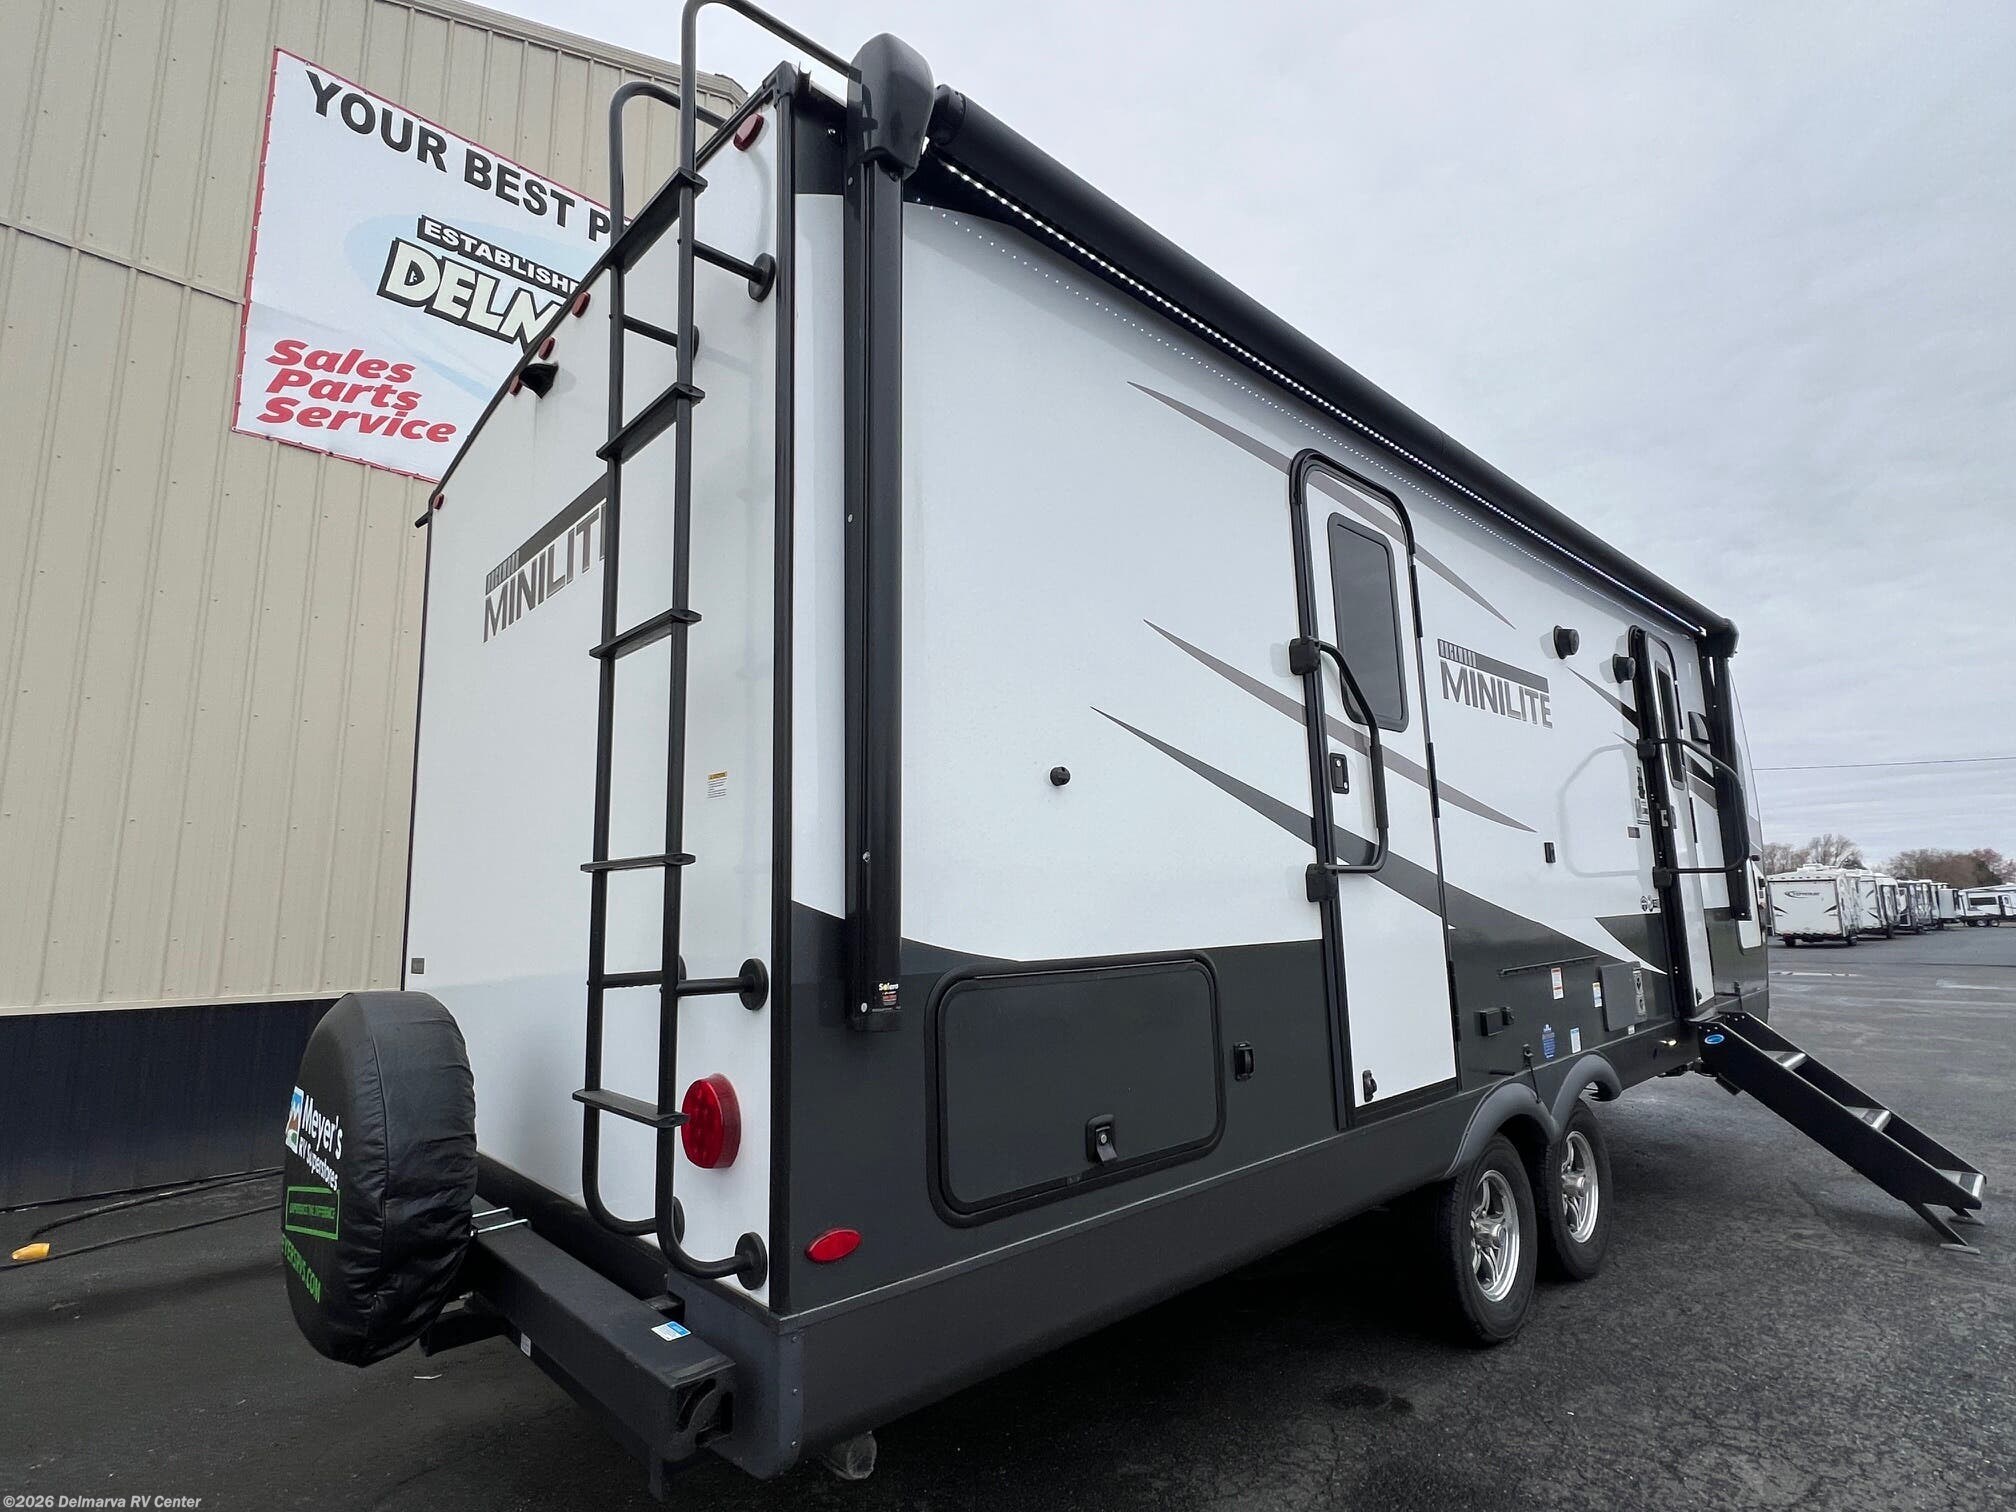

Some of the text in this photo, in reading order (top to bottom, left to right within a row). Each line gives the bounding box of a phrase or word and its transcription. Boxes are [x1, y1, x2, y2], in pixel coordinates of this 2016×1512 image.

[305, 70, 448, 173] YOUR
[464, 148, 575, 228] BEST
[265, 339, 416, 383] Sales
[265, 368, 422, 411] Parts
[256, 396, 457, 442] Service
[1440, 660, 1553, 729] MINILITE
[302, 1094, 343, 1160] Meyer's
